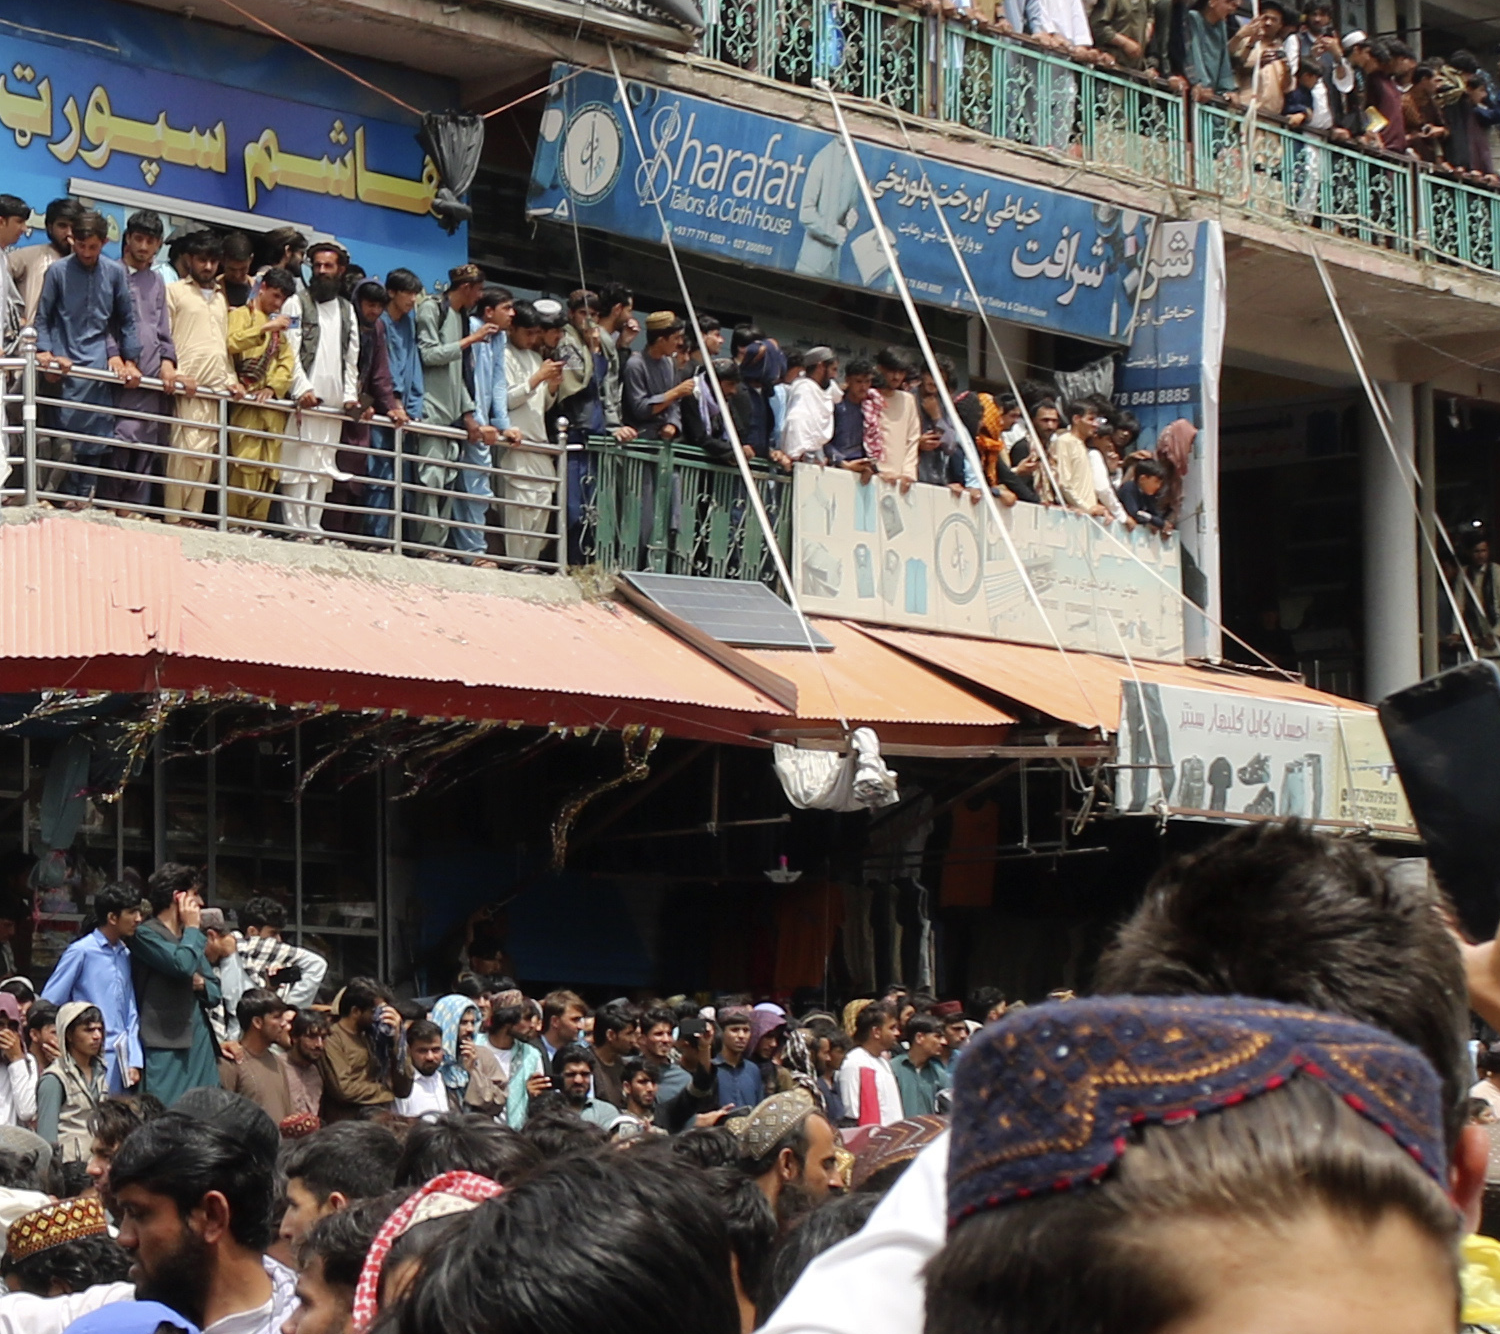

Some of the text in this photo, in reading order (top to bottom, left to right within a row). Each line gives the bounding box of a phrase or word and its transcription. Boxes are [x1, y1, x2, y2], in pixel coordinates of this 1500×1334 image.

[634, 100, 806, 210] Sharafat
[668, 183, 793, 236] Tailors & Cloth House
[1011, 225, 1107, 306] شرافت
[1131, 390, 1155, 405] 848
[1158, 387, 1190, 404] 8885
